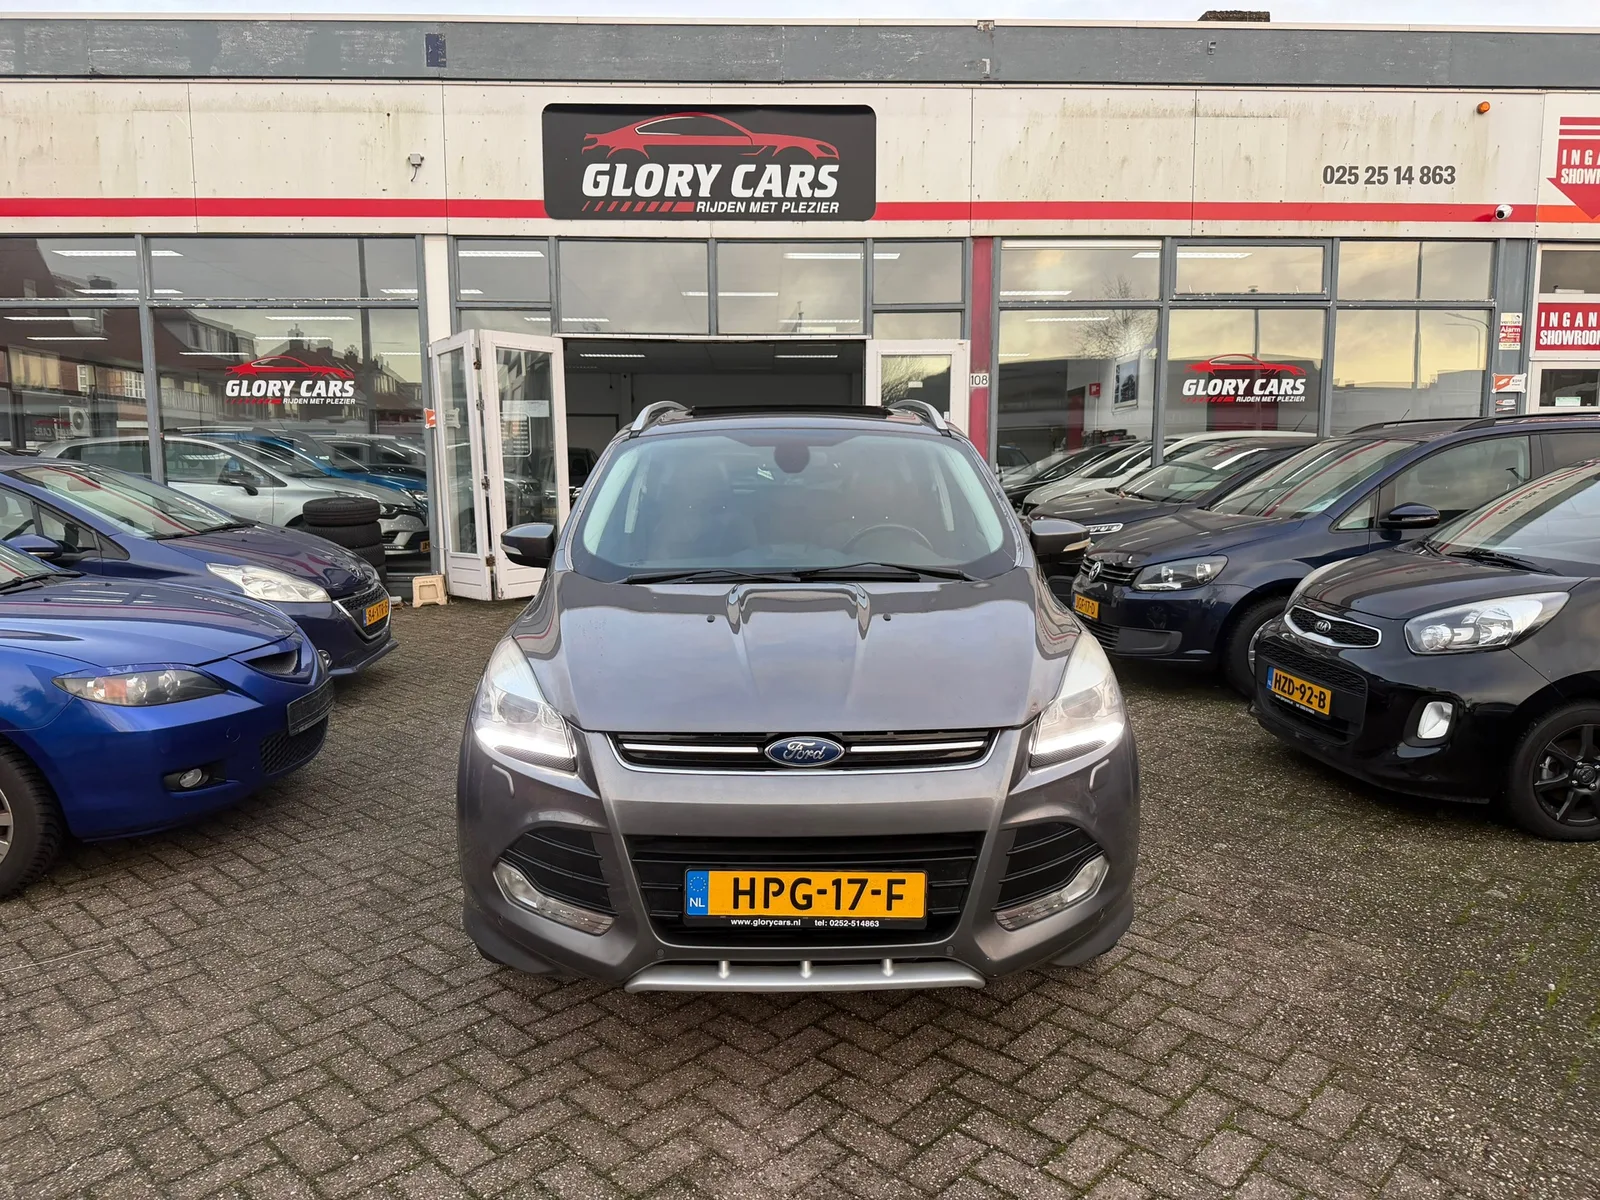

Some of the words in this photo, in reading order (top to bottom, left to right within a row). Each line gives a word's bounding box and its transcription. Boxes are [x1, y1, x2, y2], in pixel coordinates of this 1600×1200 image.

[581, 163, 722, 197] GLORY
[730, 164, 839, 198] CARS
[1322, 165, 1359, 185] 025
[1364, 165, 1389, 185] 25
[1393, 165, 1414, 185] 14
[1418, 165, 1456, 185] 863
[696, 201, 745, 213] RIJDEN
[749, 201, 778, 213] MET
[781, 201, 840, 214] PLEZIER
[1540, 311, 1598, 328] INGAN
[225, 380, 296, 397] GLORY
[300, 380, 355, 397] CARS
[971, 375, 988, 386] 108
[1182, 379, 1251, 396] GLORY
[1253, 379, 1306, 396] CARS
[1274, 672, 1327, 709] HZD-92-B
[782, 741, 826, 760] Ford
[732, 877, 907, 911] HPG-17-F
[689, 898, 706, 908] NL
[730, 918, 801, 927] www.glorycars.nl
[814, 919, 828, 927] tel:
[829, 919, 880, 928] 0252-514863
